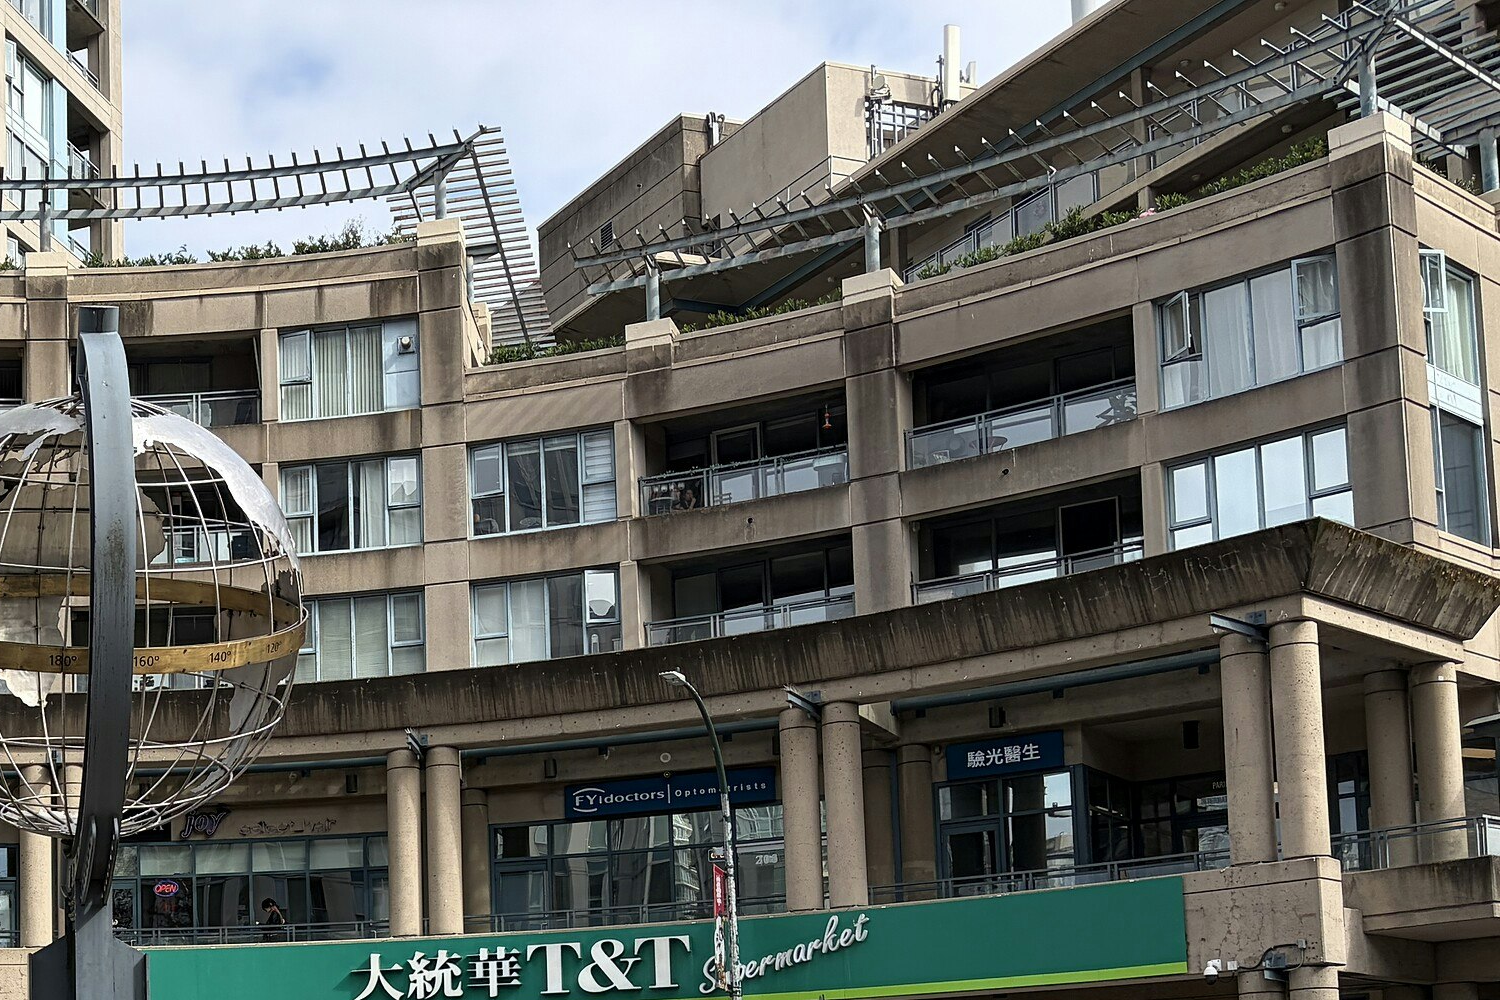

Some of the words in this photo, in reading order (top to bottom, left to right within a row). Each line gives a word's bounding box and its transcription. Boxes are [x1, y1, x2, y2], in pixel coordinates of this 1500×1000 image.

[49, 655, 78, 667] 180°
[133, 655, 160, 667] 160°
[209, 650, 232, 663] 140°
[967, 743, 1041, 768] 驗光醫生
[675, 781, 766, 799] Optomtrists
[180, 808, 233, 839] joy
[155, 883, 178, 895] OPEN
[527, 935, 691, 995] T&T
[699, 912, 870, 995] Spermarket
